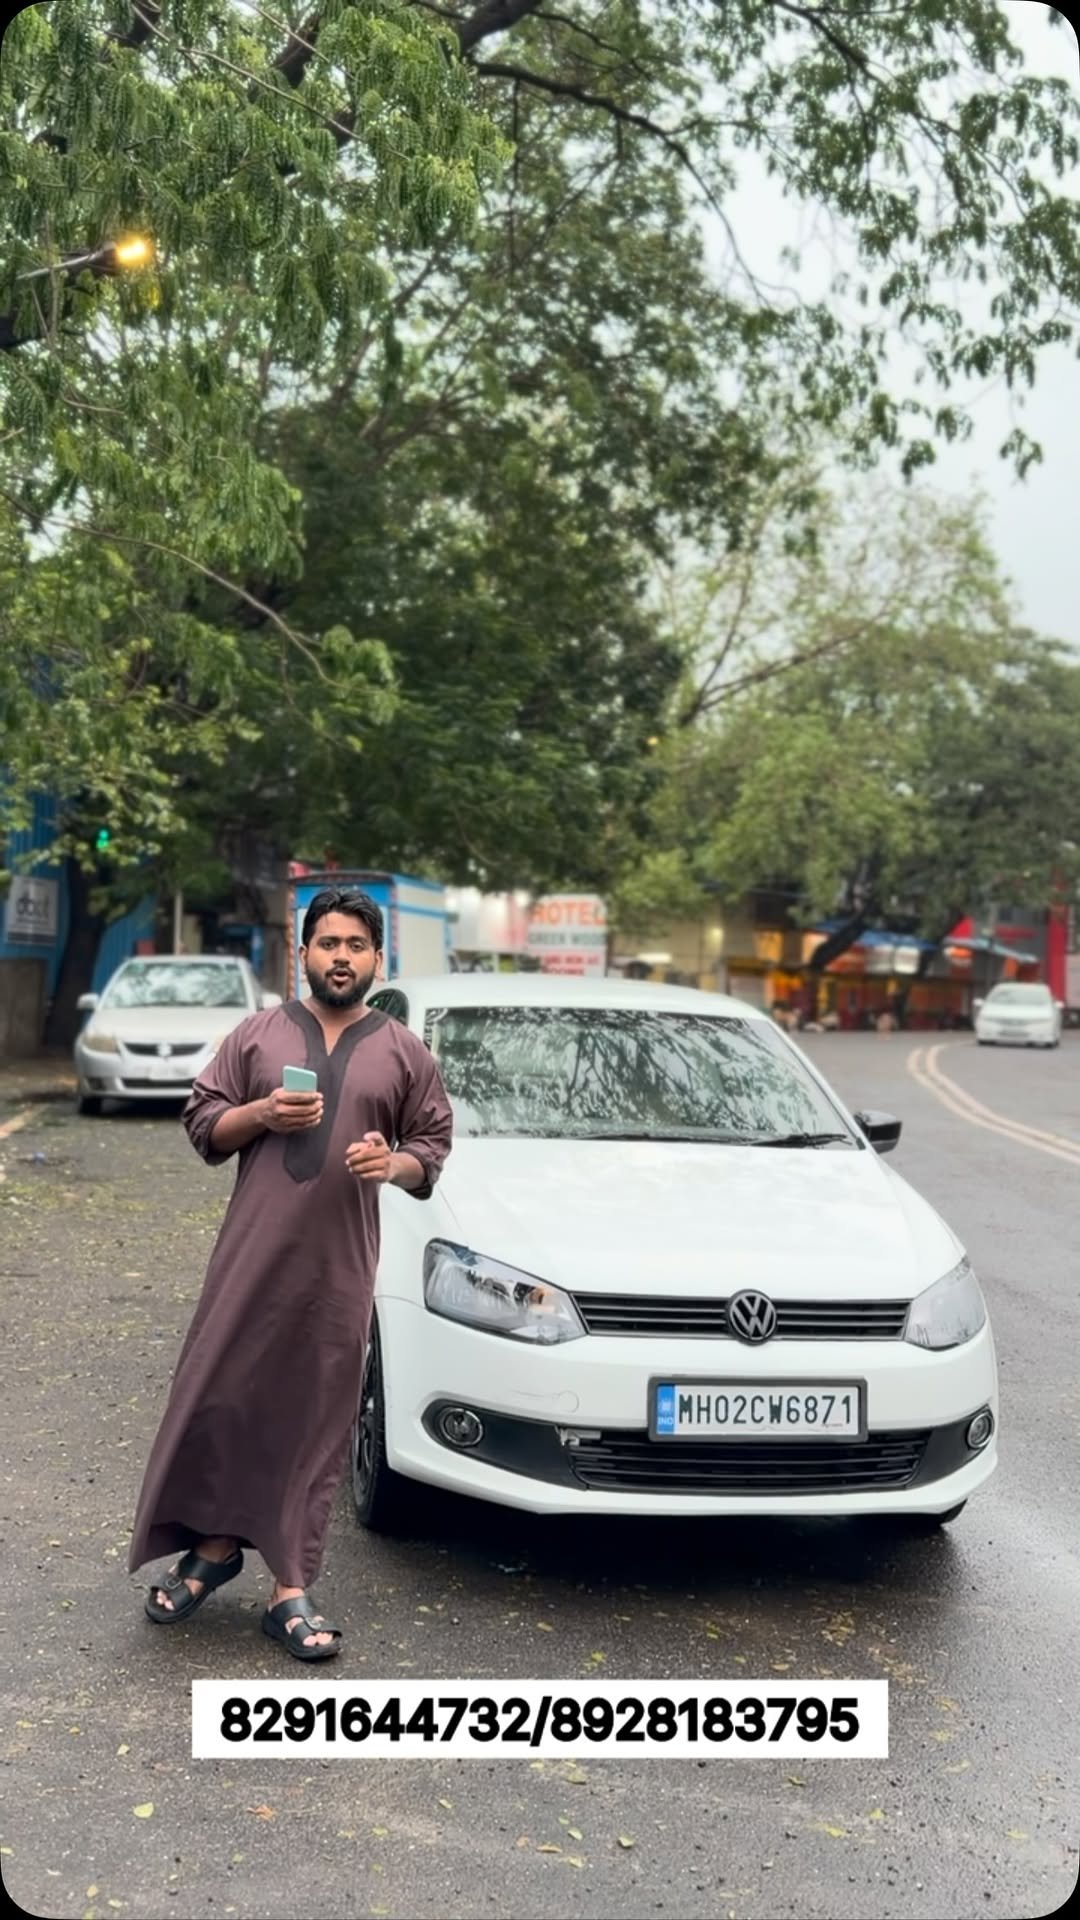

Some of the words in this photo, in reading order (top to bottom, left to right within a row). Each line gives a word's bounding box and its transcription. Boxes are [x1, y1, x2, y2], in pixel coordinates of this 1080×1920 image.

[530, 901, 606, 925] HOTEL
[657, 1416, 674, 1425] IND
[678, 1394, 851, 1425] MH02CW6871
